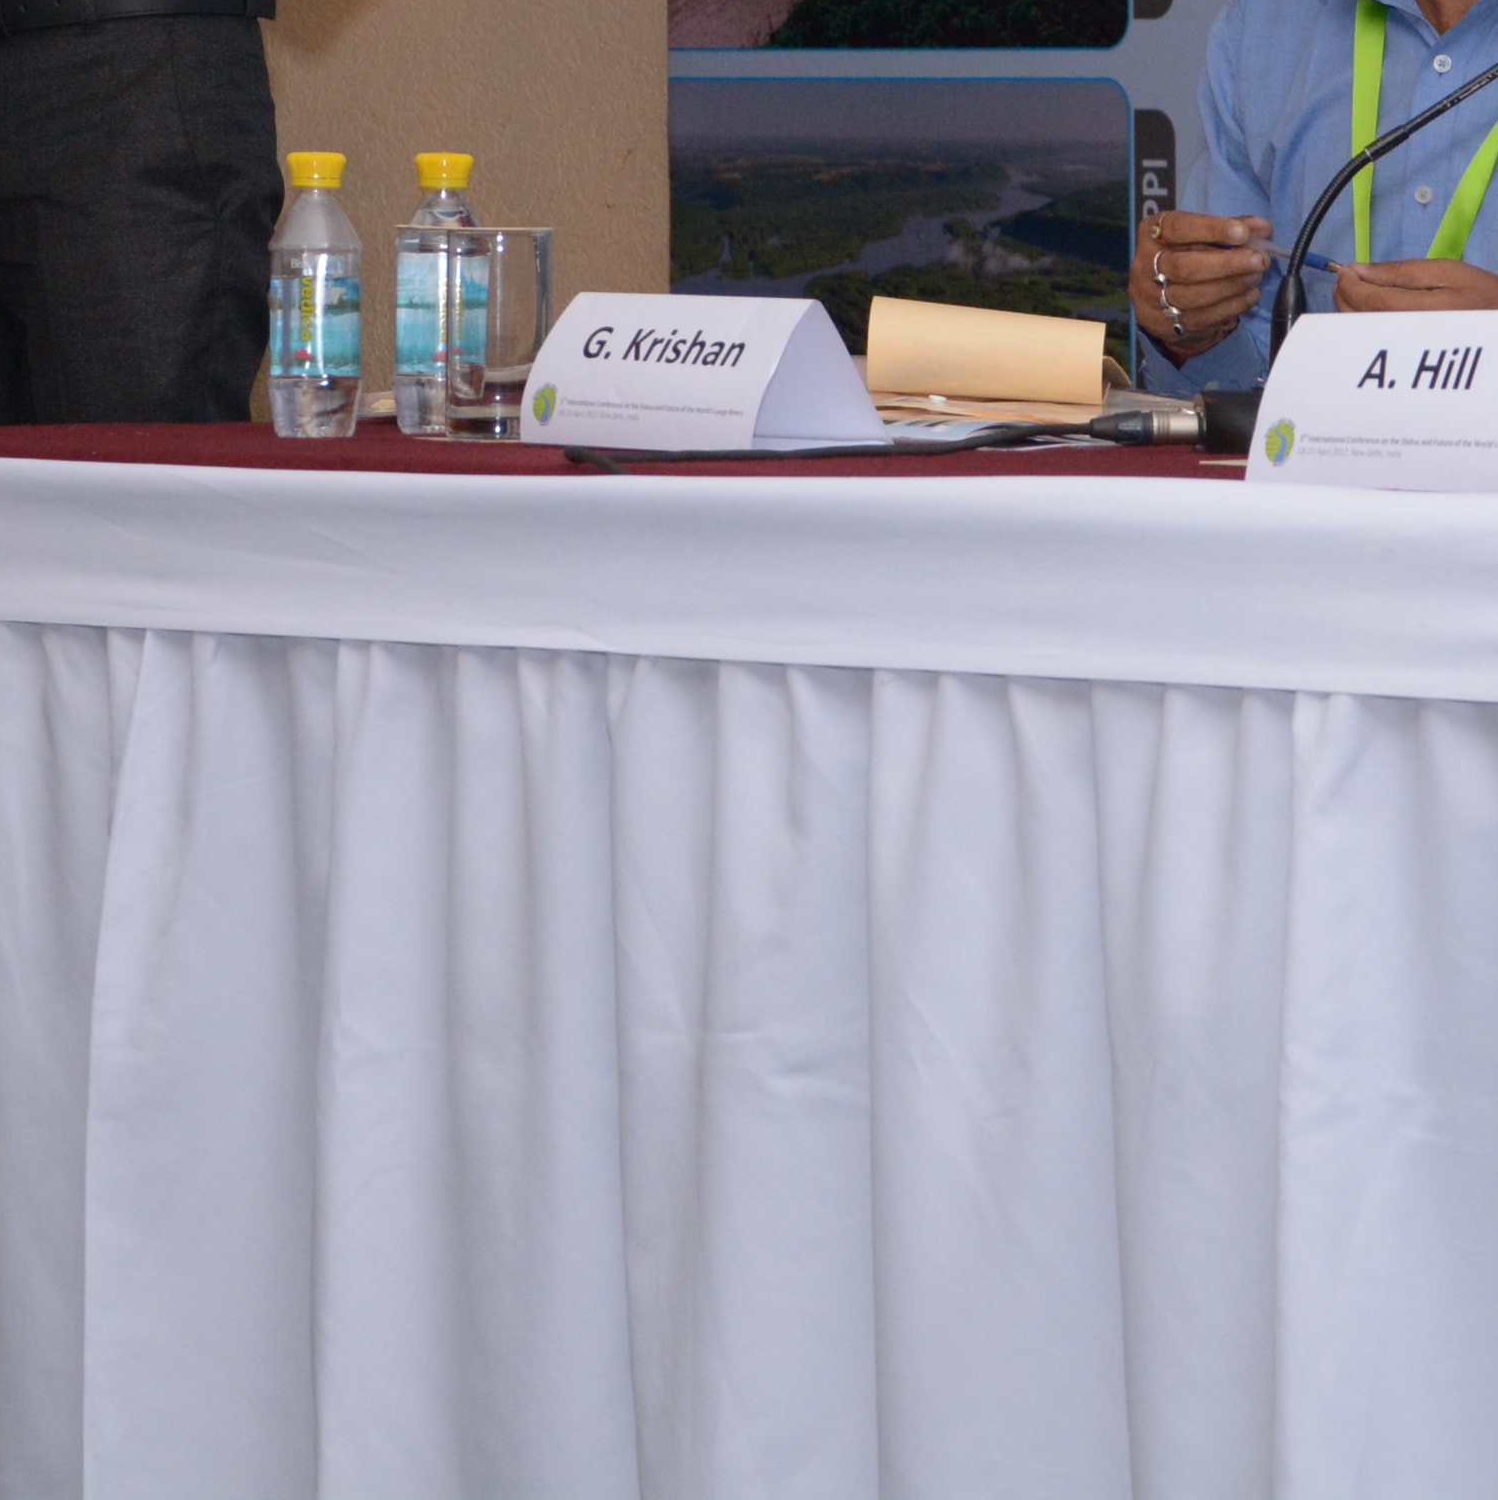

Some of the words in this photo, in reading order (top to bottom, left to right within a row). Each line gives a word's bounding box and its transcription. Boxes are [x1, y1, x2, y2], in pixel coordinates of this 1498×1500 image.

[582, 326, 614, 359] G.
[622, 328, 746, 367] Krishan
[1357, 349, 1396, 389] A.
[1411, 347, 1483, 390] Hill
